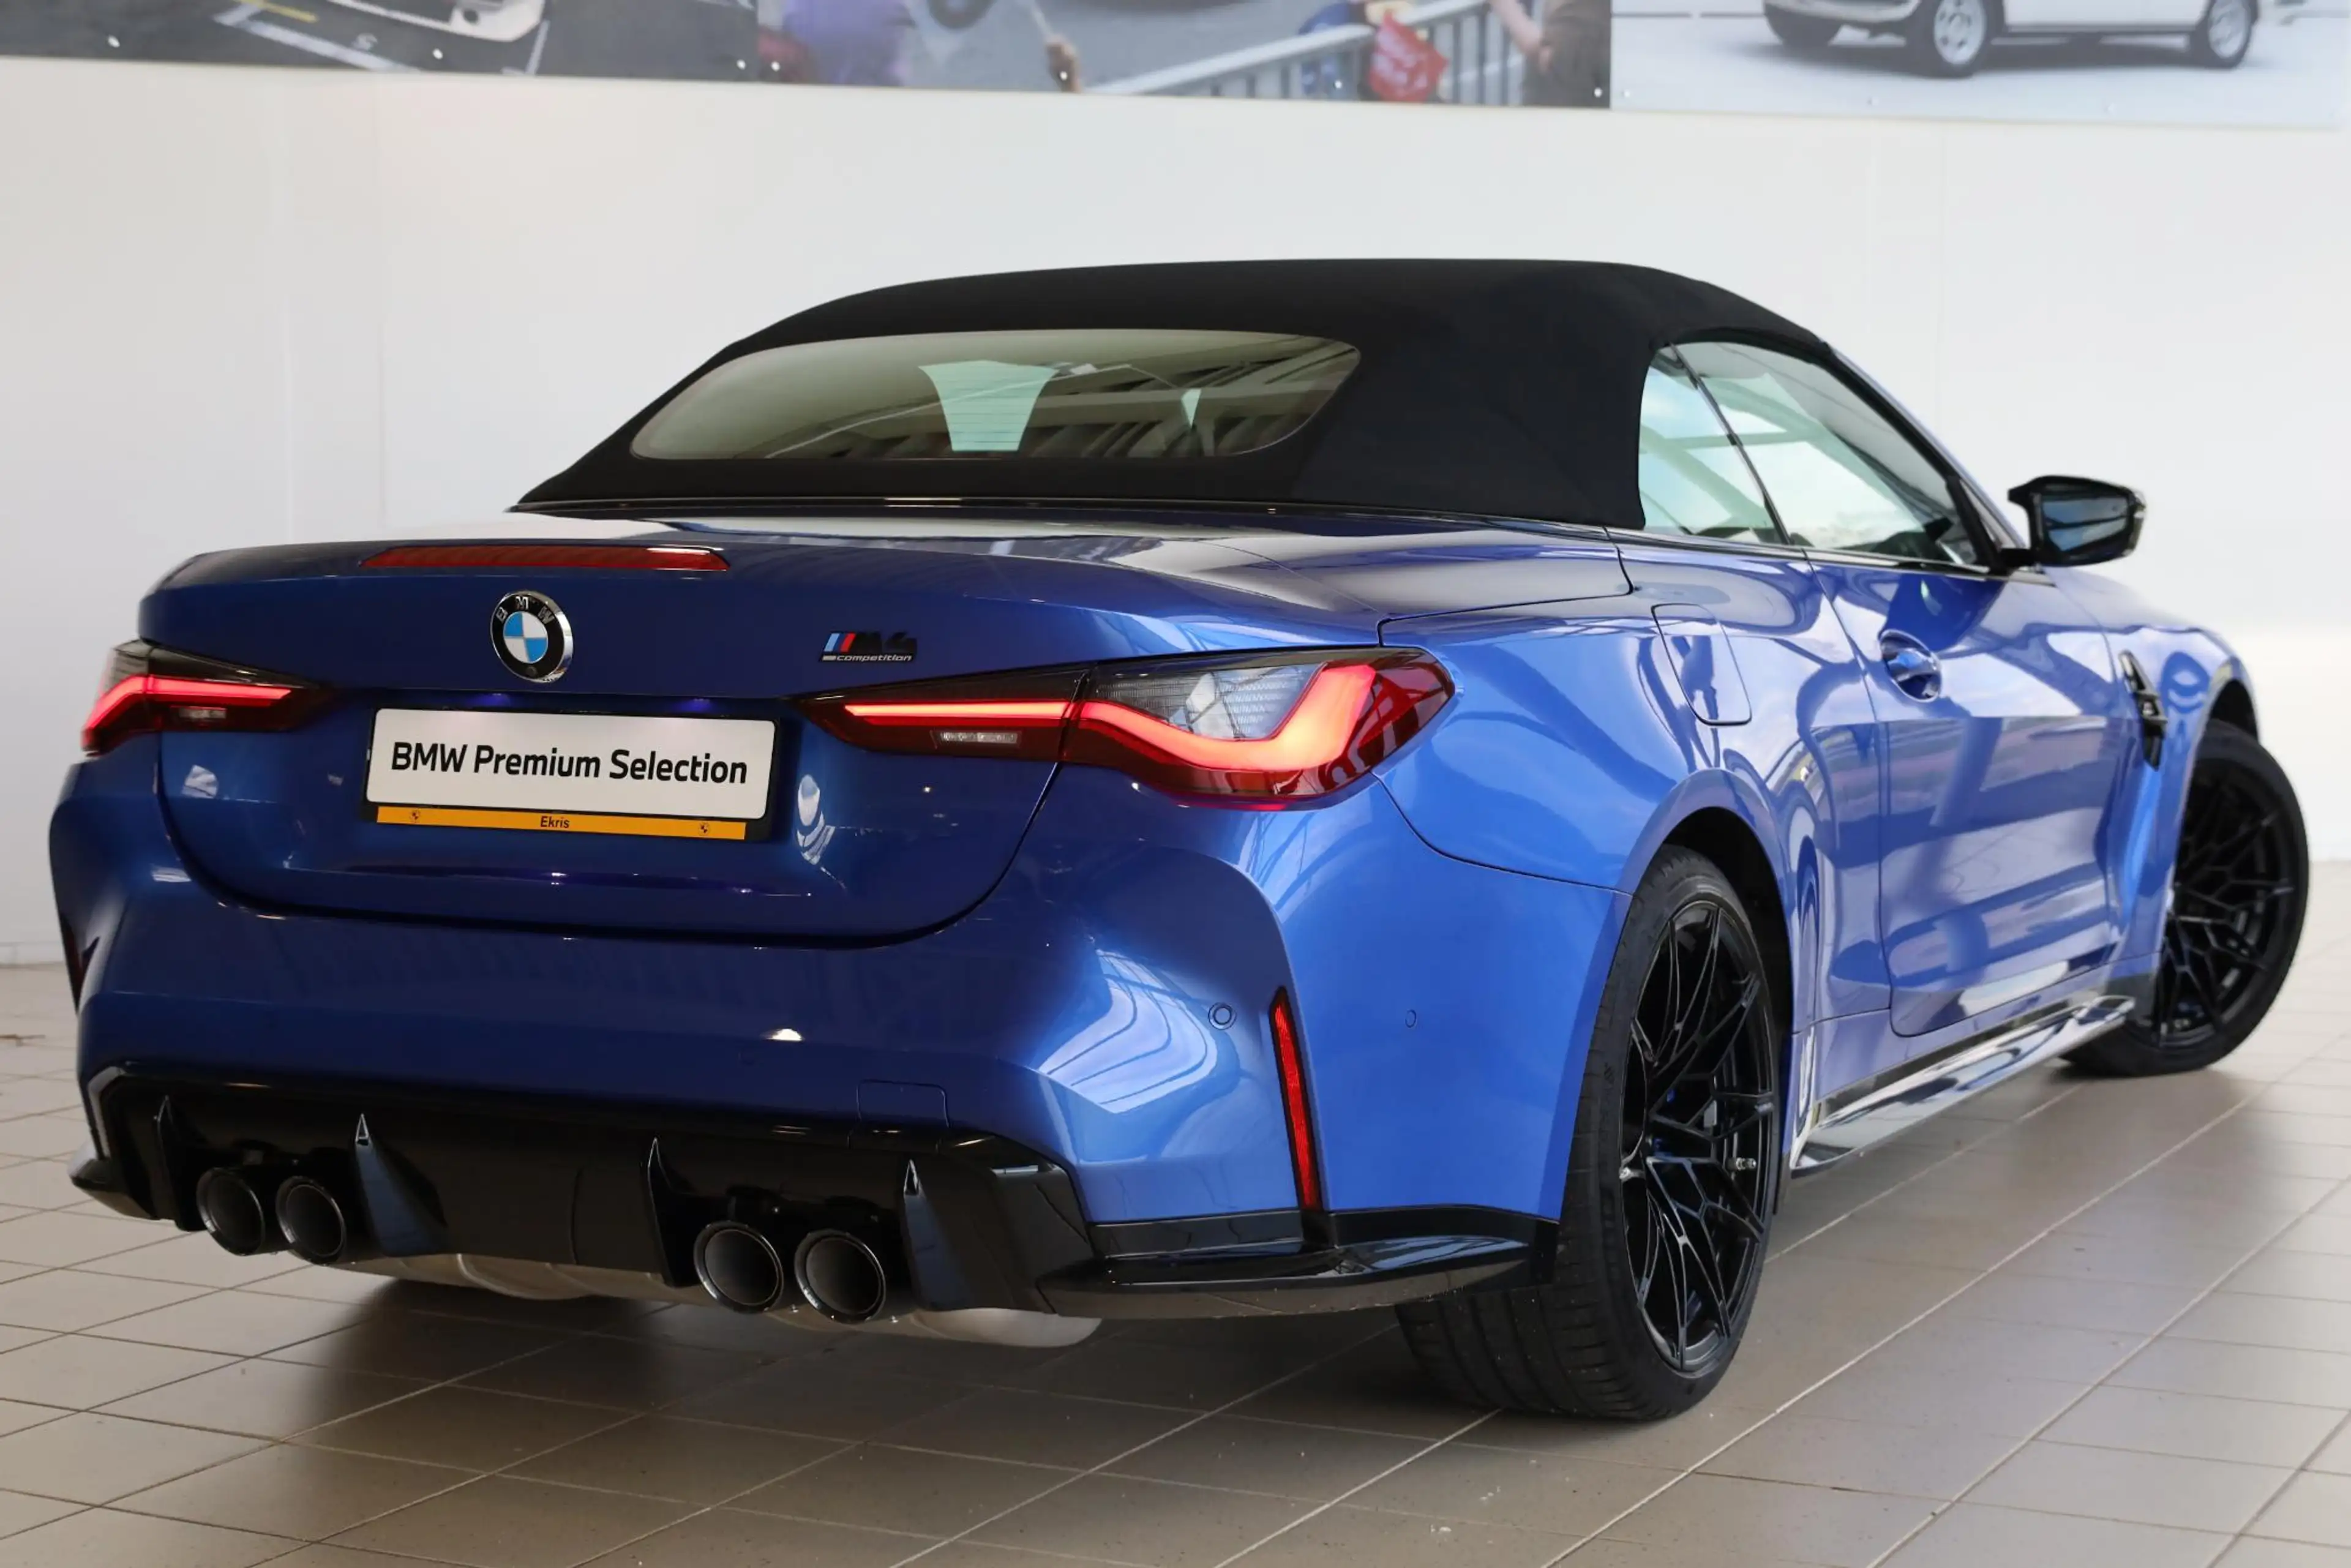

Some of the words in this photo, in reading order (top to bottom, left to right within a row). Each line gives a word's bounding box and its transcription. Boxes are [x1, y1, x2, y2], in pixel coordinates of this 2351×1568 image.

[495, 596, 555, 625] BMW
[836, 654, 912, 662] competition
[391, 741, 468, 773] BMW
[474, 745, 601, 778] Premium
[609, 749, 747, 784] Selection
[540, 815, 569, 828] Ekris
